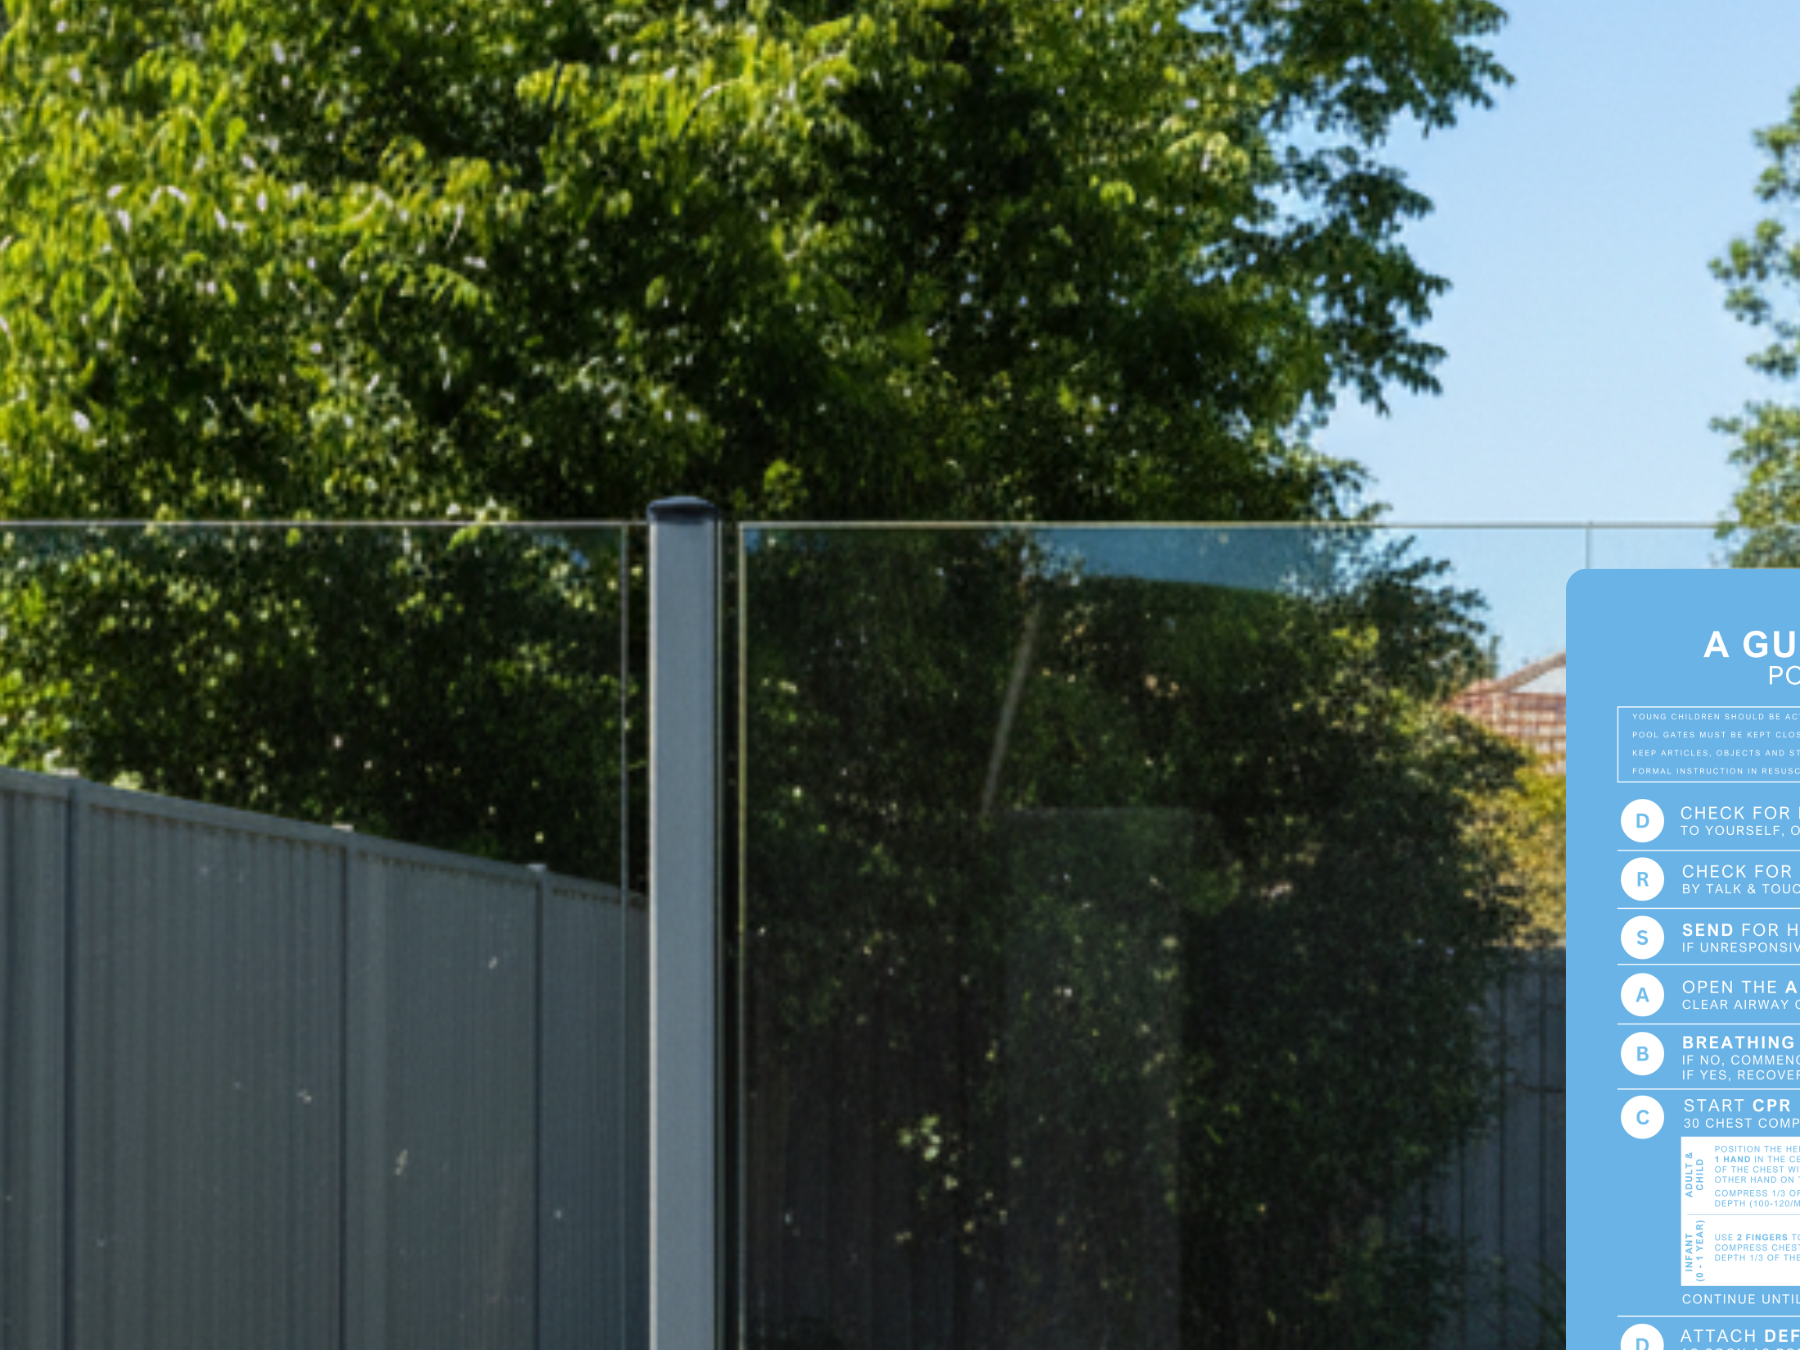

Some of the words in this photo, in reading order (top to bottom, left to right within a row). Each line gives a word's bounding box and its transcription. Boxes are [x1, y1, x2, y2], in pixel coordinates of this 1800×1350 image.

[1703, 630, 1730, 658] A
[1661, 749, 1711, 757] ARTICLES,
[1680, 806, 1745, 820] CHECK
[1753, 806, 1790, 820] FOR
[1636, 813, 1650, 829] D
[1680, 825, 1699, 836] TO
[1705, 825, 1784, 837] YOURSELF,
[1682, 864, 1746, 878] CHECK
[1755, 864, 1792, 878] FOR
[1637, 871, 1649, 887] R
[1682, 883, 1700, 894] BY
[1706, 883, 1741, 894] TALK
[1747, 883, 1756, 894] &
[1682, 923, 1733, 937] SEND
[1742, 923, 1779, 937] FOR
[1637, 929, 1649, 946] S
[1682, 942, 1694, 953] IF
[1682, 980, 1733, 994] OPEN
[1741, 980, 1777, 994] THE
[1635, 987, 1650, 1003] A
[1682, 999, 1728, 1010] CLEAR
[1733, 999, 1789, 1010] AIRWAY
[1683, 1035, 1794, 1049] BREATHING
[1637, 1046, 1649, 1062] B
[1682, 1055, 1694, 1065] IF
[1700, 1054, 1725, 1066] NO,
[1682, 1069, 1694, 1080] IF
[1700, 1069, 1731, 1081] YES,
[1684, 1098, 1745, 1112] START
[1752, 1098, 1790, 1112] CPR
[1636, 1109, 1650, 1125] C
[1684, 1118, 1699, 1129] 30
[1705, 1118, 1752, 1129] CHEST
[1715, 1145, 1760, 1153] POSITION
[1764, 1145, 1782, 1153] THE
[1723, 1155, 1751, 1163] HAND
[1767, 1155, 1785, 1163] THE
[1685, 1163, 1693, 1198] ADULT
[1695, 1159, 1704, 1191] CHILD
[1714, 1189, 1768, 1197] COMPRESS
[1772, 1189, 1785, 1197] 1/3
[1715, 1233, 1733, 1241] USE
[1737, 1233, 1742, 1241] 2
[1746, 1233, 1788, 1241] FINGERS
[1685, 1233, 1693, 1272] INFANT
[1714, 1243, 1768, 1252] COMPRESS
[1682, 1293, 1755, 1304] CONTINUE
[1680, 1329, 1755, 1343] ATTACH
